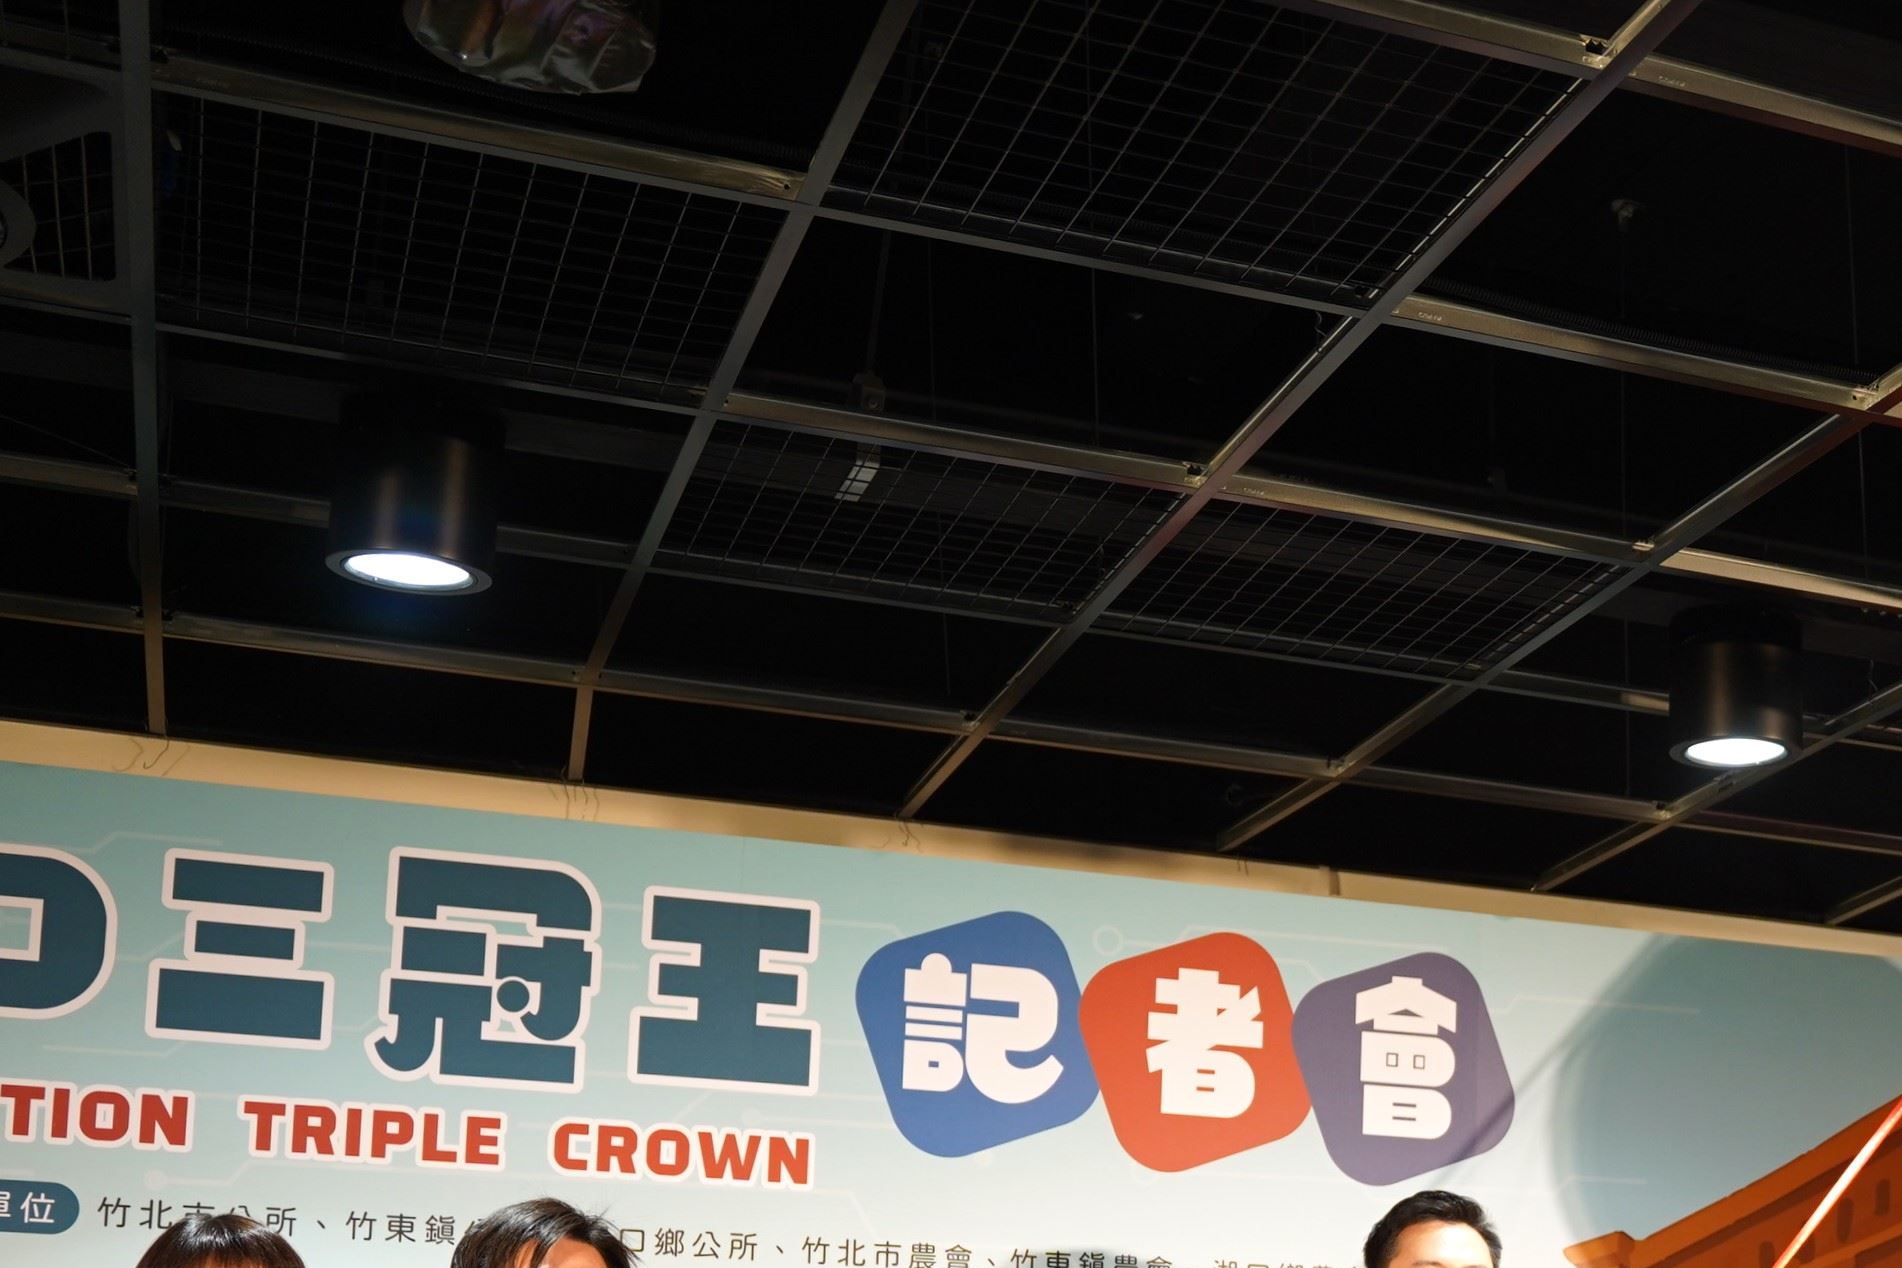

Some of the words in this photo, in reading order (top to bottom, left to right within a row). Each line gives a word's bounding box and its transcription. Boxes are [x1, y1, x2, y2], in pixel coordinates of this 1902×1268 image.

[901, 952, 1458, 1140] 記者會
[1, 1084, 190, 1146] TION
[243, 1101, 503, 1166] TRIPLE
[552, 1122, 811, 1186] CROWN
